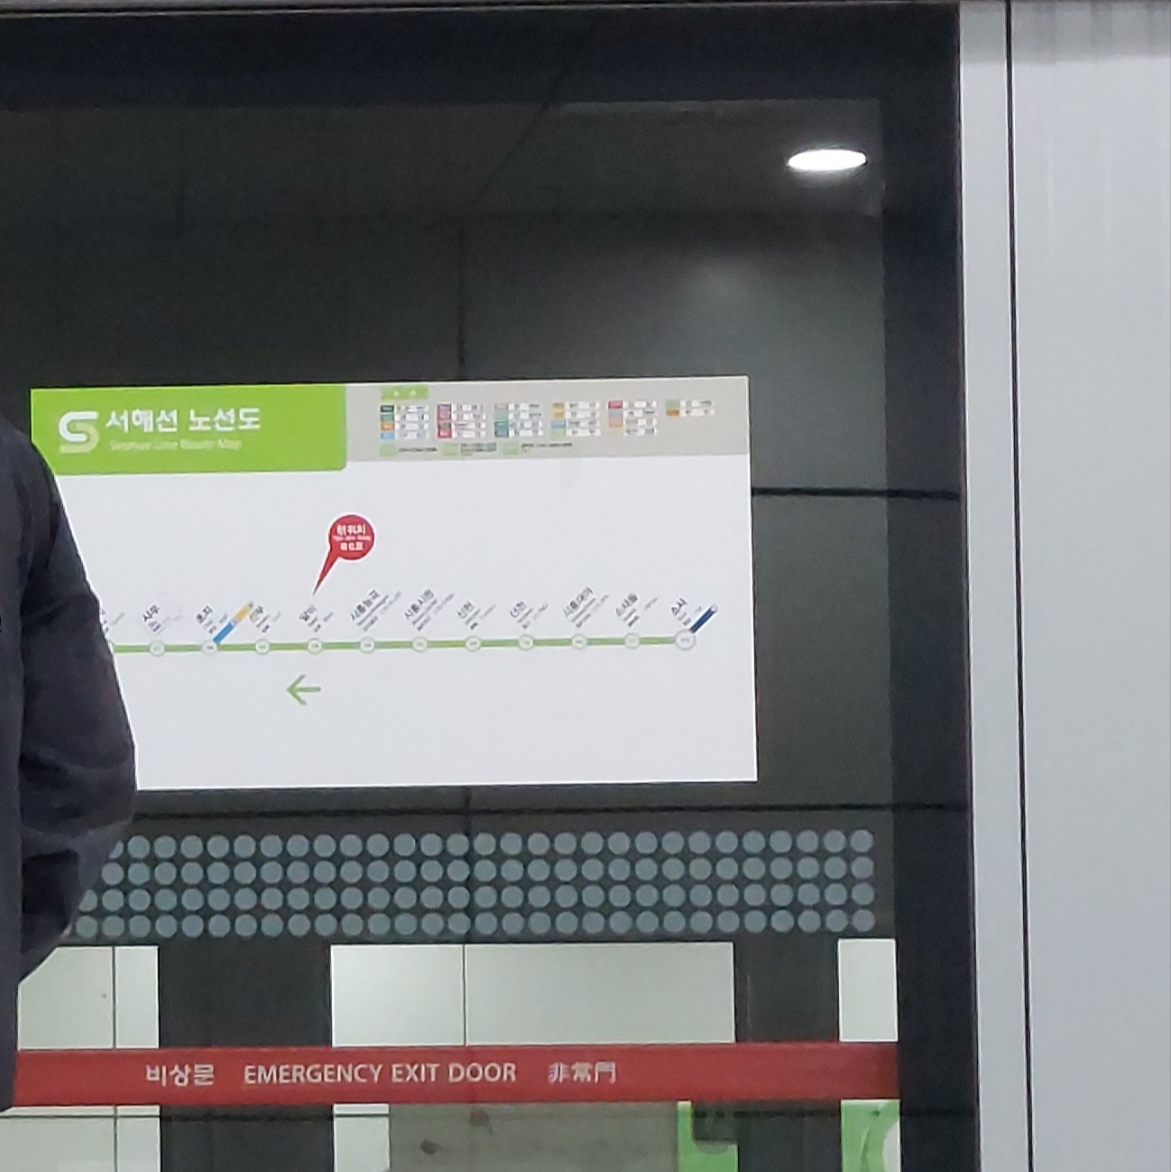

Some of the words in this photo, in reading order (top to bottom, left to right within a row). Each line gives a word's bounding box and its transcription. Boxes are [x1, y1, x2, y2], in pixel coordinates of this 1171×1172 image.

[105, 409, 178, 433] 서해선
[188, 407, 261, 431] 노선도
[145, 1063, 215, 1088] 비상문
[244, 1063, 384, 1084] EMERGENCY
[391, 1063, 440, 1083] EXIT
[448, 1062, 517, 1083] DOOR
[548, 1061, 616, 1084] 非常門
